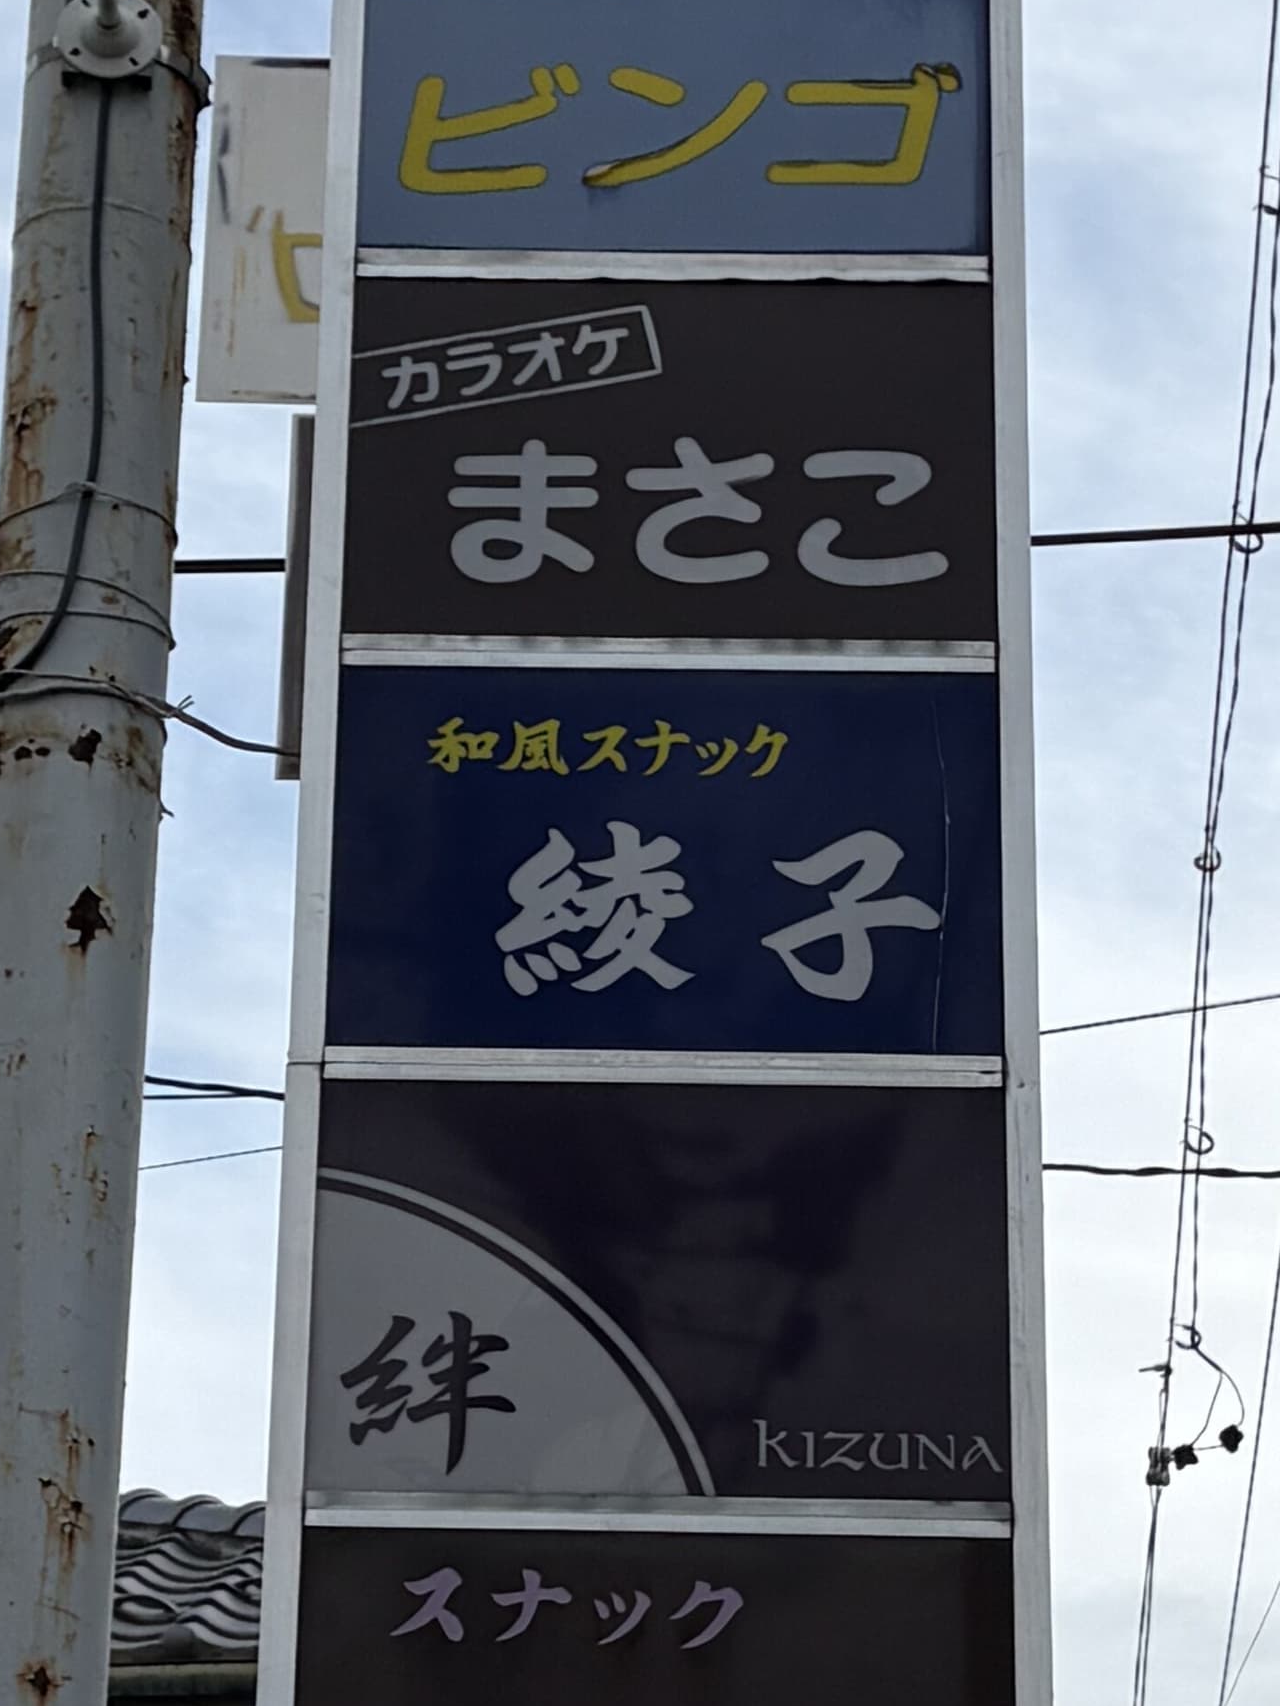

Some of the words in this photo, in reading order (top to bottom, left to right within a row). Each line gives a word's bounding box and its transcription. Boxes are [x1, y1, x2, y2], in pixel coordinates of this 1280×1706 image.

[398, 62, 963, 194] ビンゴ
[381, 324, 630, 410] カラオケ
[448, 436, 949, 588] まさこ
[428, 717, 789, 778] 和風スナック
[495, 820, 941, 1001] 綾子
[340, 1311, 516, 1475] 絆
[753, 1419, 1003, 1473] KIZUNA
[390, 1567, 744, 1649] スナック
